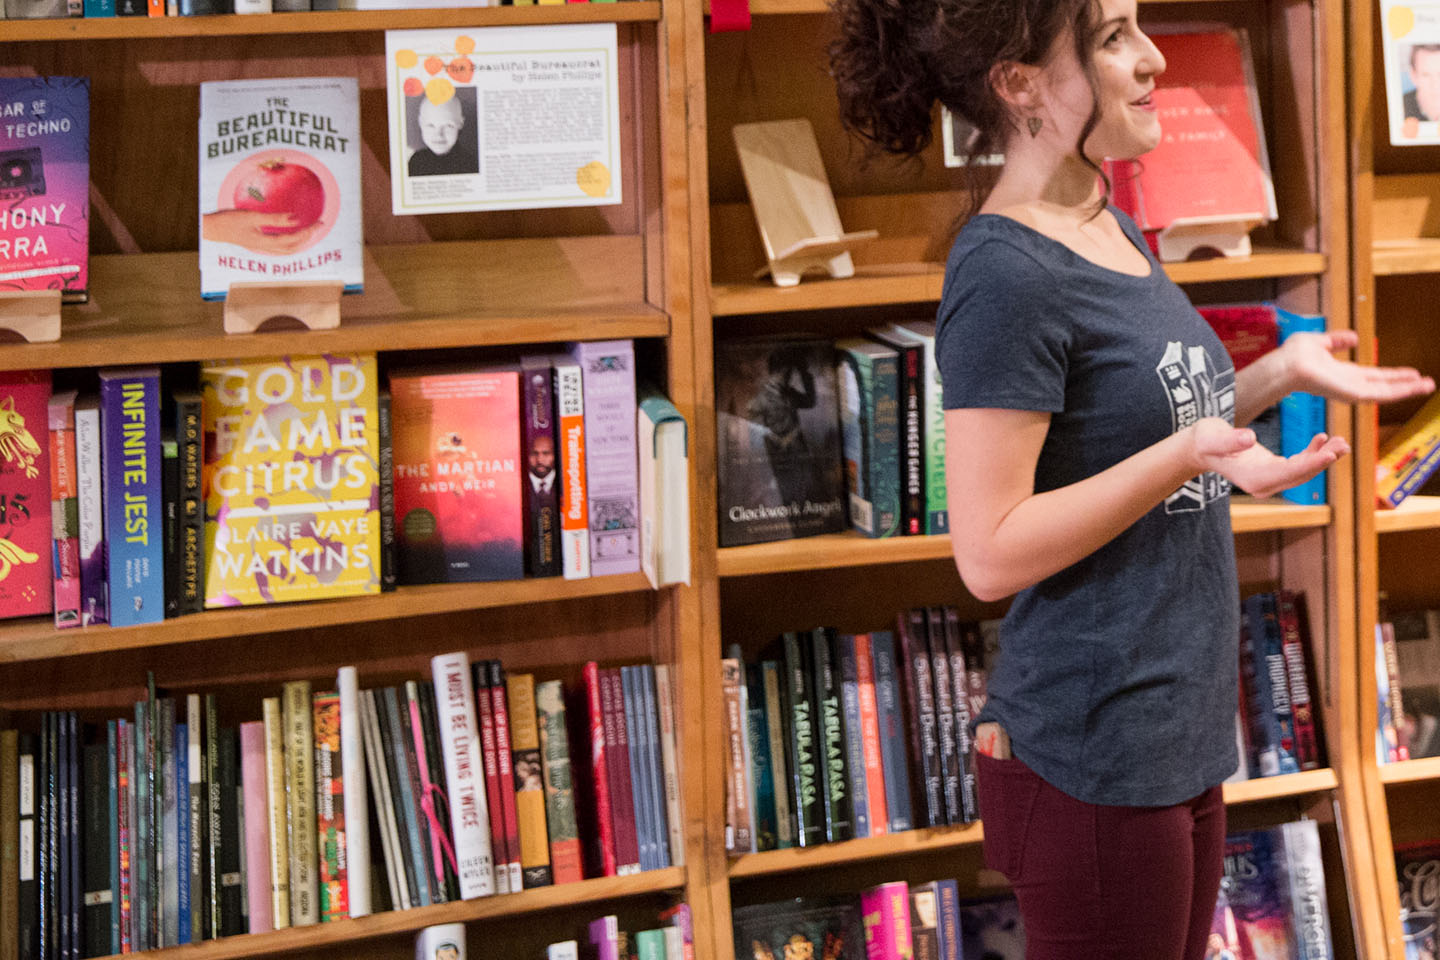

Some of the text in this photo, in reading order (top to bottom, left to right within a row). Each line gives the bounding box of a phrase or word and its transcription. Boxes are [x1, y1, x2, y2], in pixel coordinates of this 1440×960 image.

[216, 109, 339, 138] BEAUTIFUL
[266, 96, 289, 108] THE
[6, 117, 71, 140] TECHNO
[206, 128, 350, 159] BUREAUCRAT
[217, 248, 343, 277] HELEN PHILLIPS
[215, 362, 367, 407] GOLD
[215, 407, 368, 455] FAME
[907, 411, 919, 458] HUNGER
[121, 382, 149, 546] INFINITE JEST
[186, 444, 198, 489] WATERS
[213, 455, 367, 498] CITRUS
[396, 458, 515, 479] THE MARTIAN
[567, 425, 584, 520] Trainspotting
[309, 517, 369, 538] VAYE
[729, 502, 801, 523] Clockwork
[185, 527, 197, 598] ARCHETYPE
[216, 544, 370, 580] WATKINS
[447, 672, 466, 709] MUST
[1264, 654, 1291, 715] PROPHECY
[453, 714, 467, 729] BE
[454, 735, 474, 780] LIVING
[793, 700, 817, 807] TABULA RASA
[821, 696, 846, 802] TABULA RASA
[459, 784, 480, 830] TWICE
